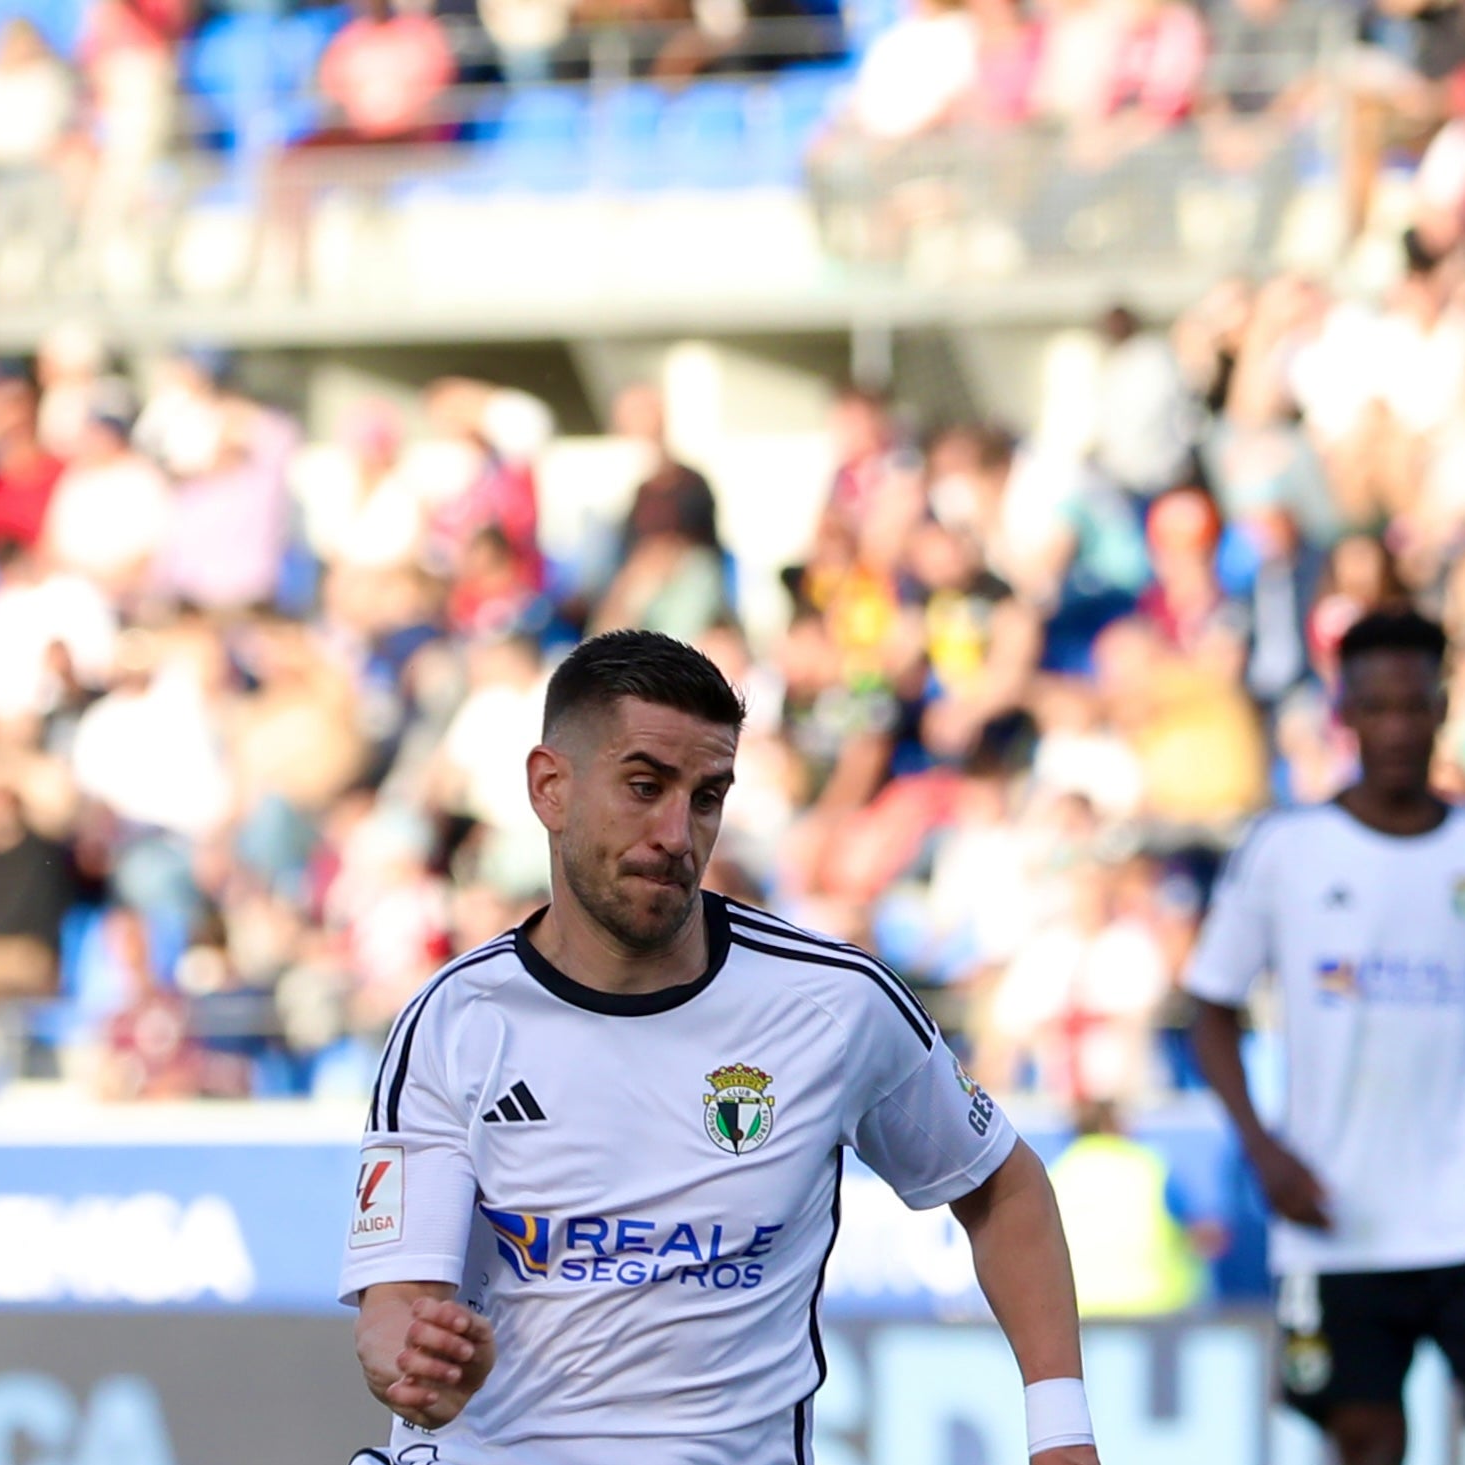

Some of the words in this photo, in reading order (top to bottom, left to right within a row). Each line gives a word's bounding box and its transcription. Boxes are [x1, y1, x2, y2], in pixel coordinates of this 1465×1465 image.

[726, 1088, 751, 1098] CLUB
[565, 1216, 784, 1263] REALE
[560, 1256, 764, 1290] SEGUROS
